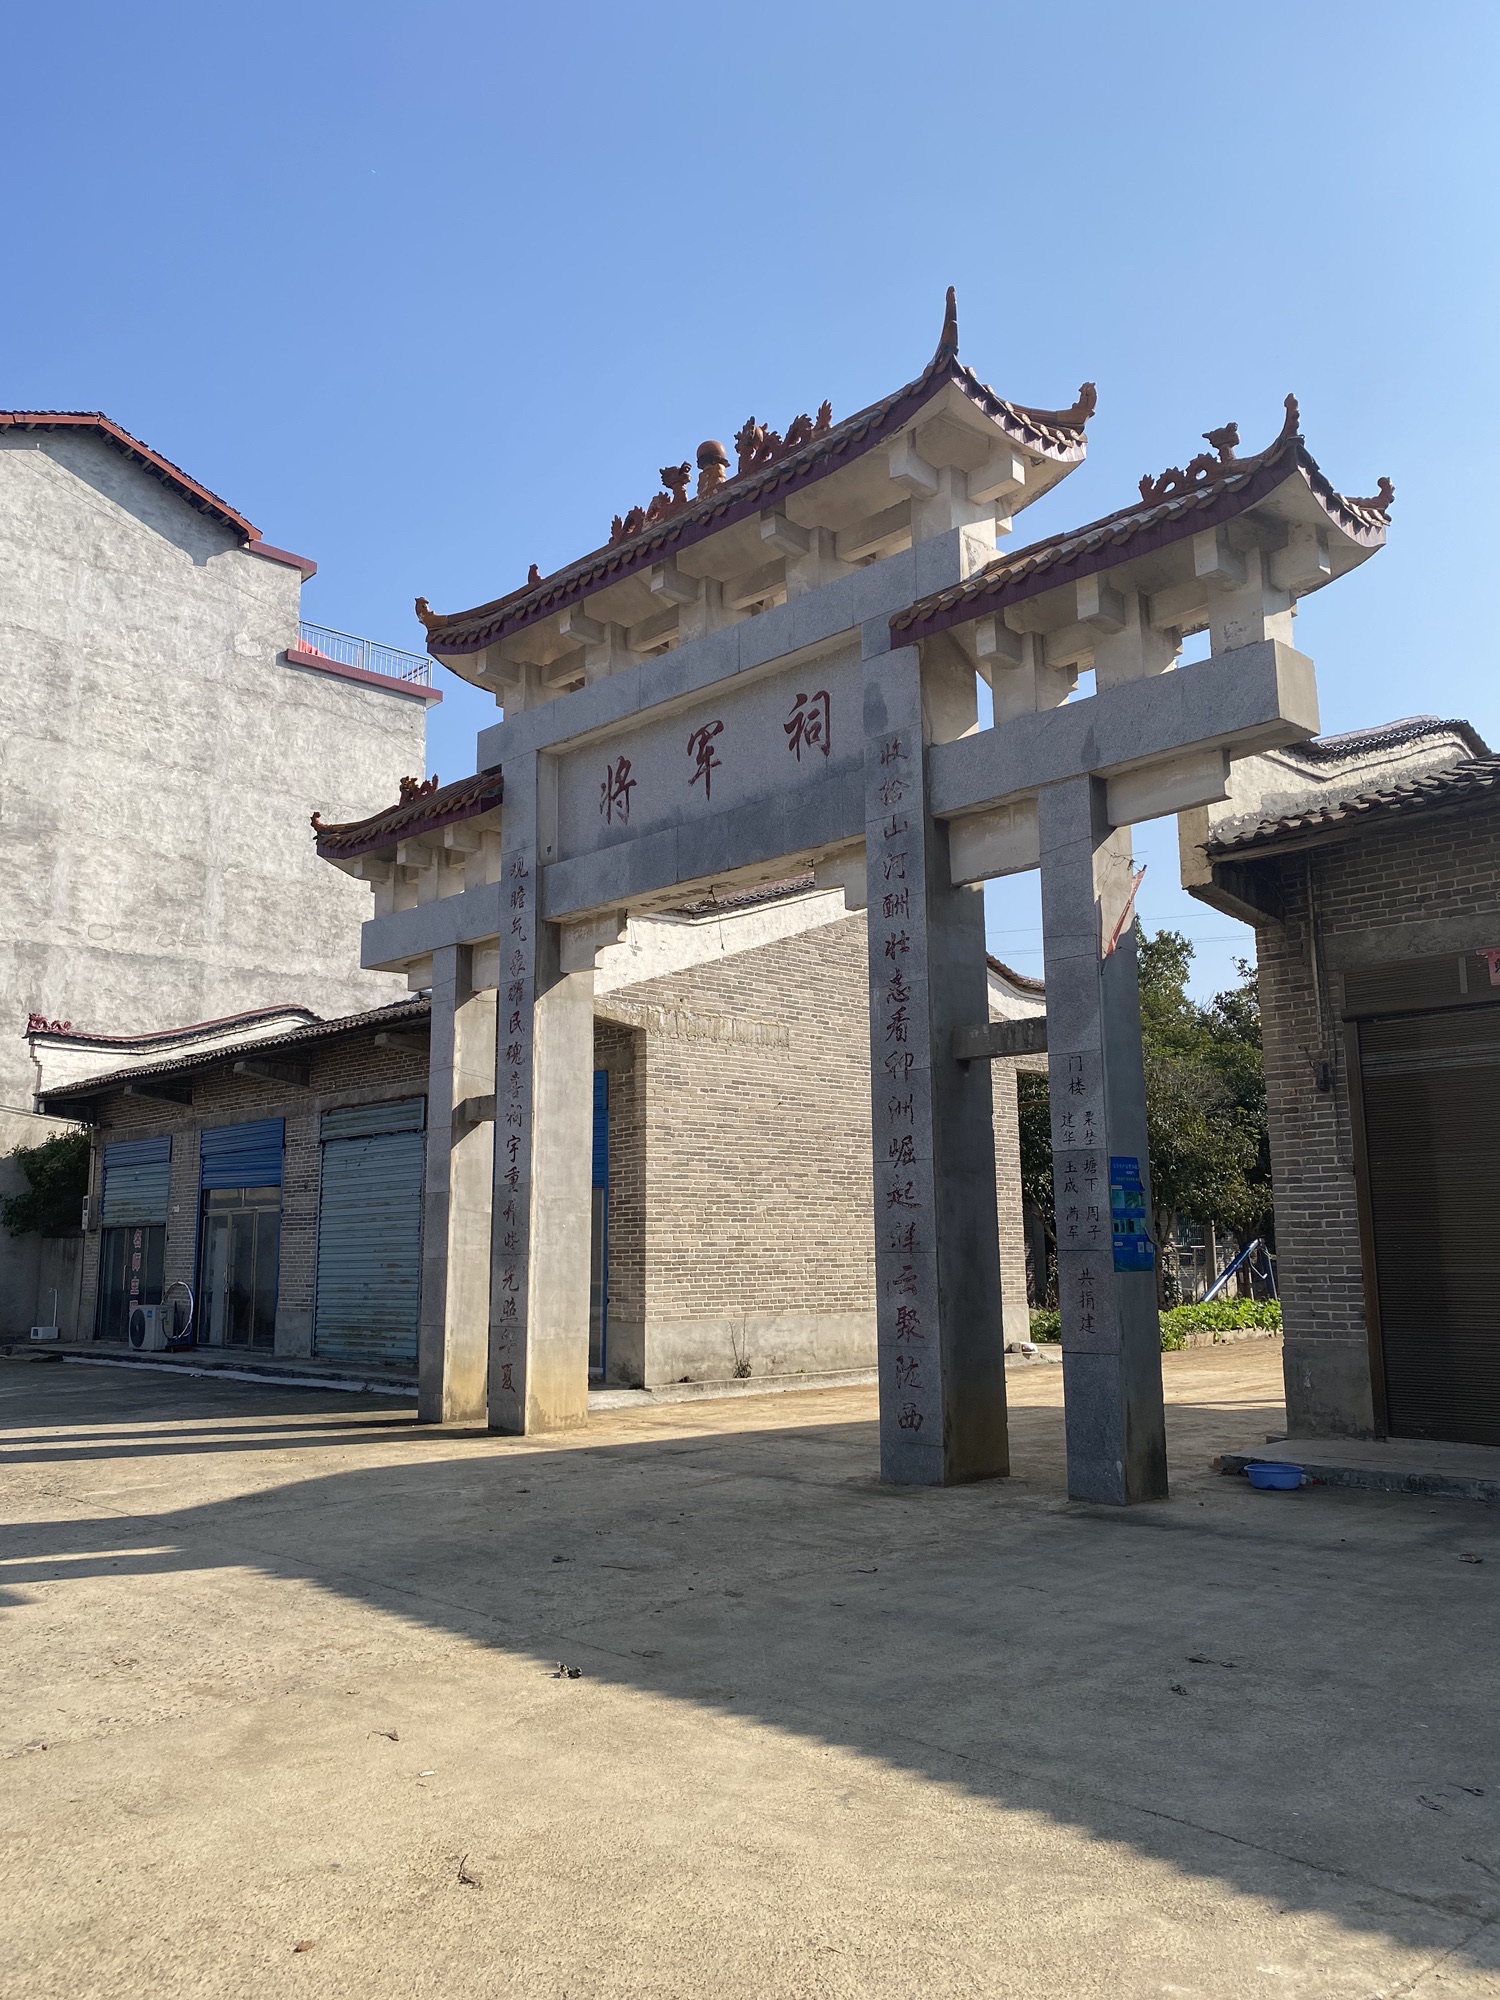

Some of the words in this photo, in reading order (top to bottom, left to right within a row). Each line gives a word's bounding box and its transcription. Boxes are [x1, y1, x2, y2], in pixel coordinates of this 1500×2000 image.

[599, 690, 832, 826] 将军祠
[1068, 1056, 1086, 1095] 门楼
[1061, 1111, 1076, 1145] 建华
[1064, 1161, 1078, 1193] 玉成
[1081, 1158, 1099, 1192] 塘下
[1086, 1206, 1102, 1240] 周子
[1078, 1268, 1096, 1334] 共捐建
